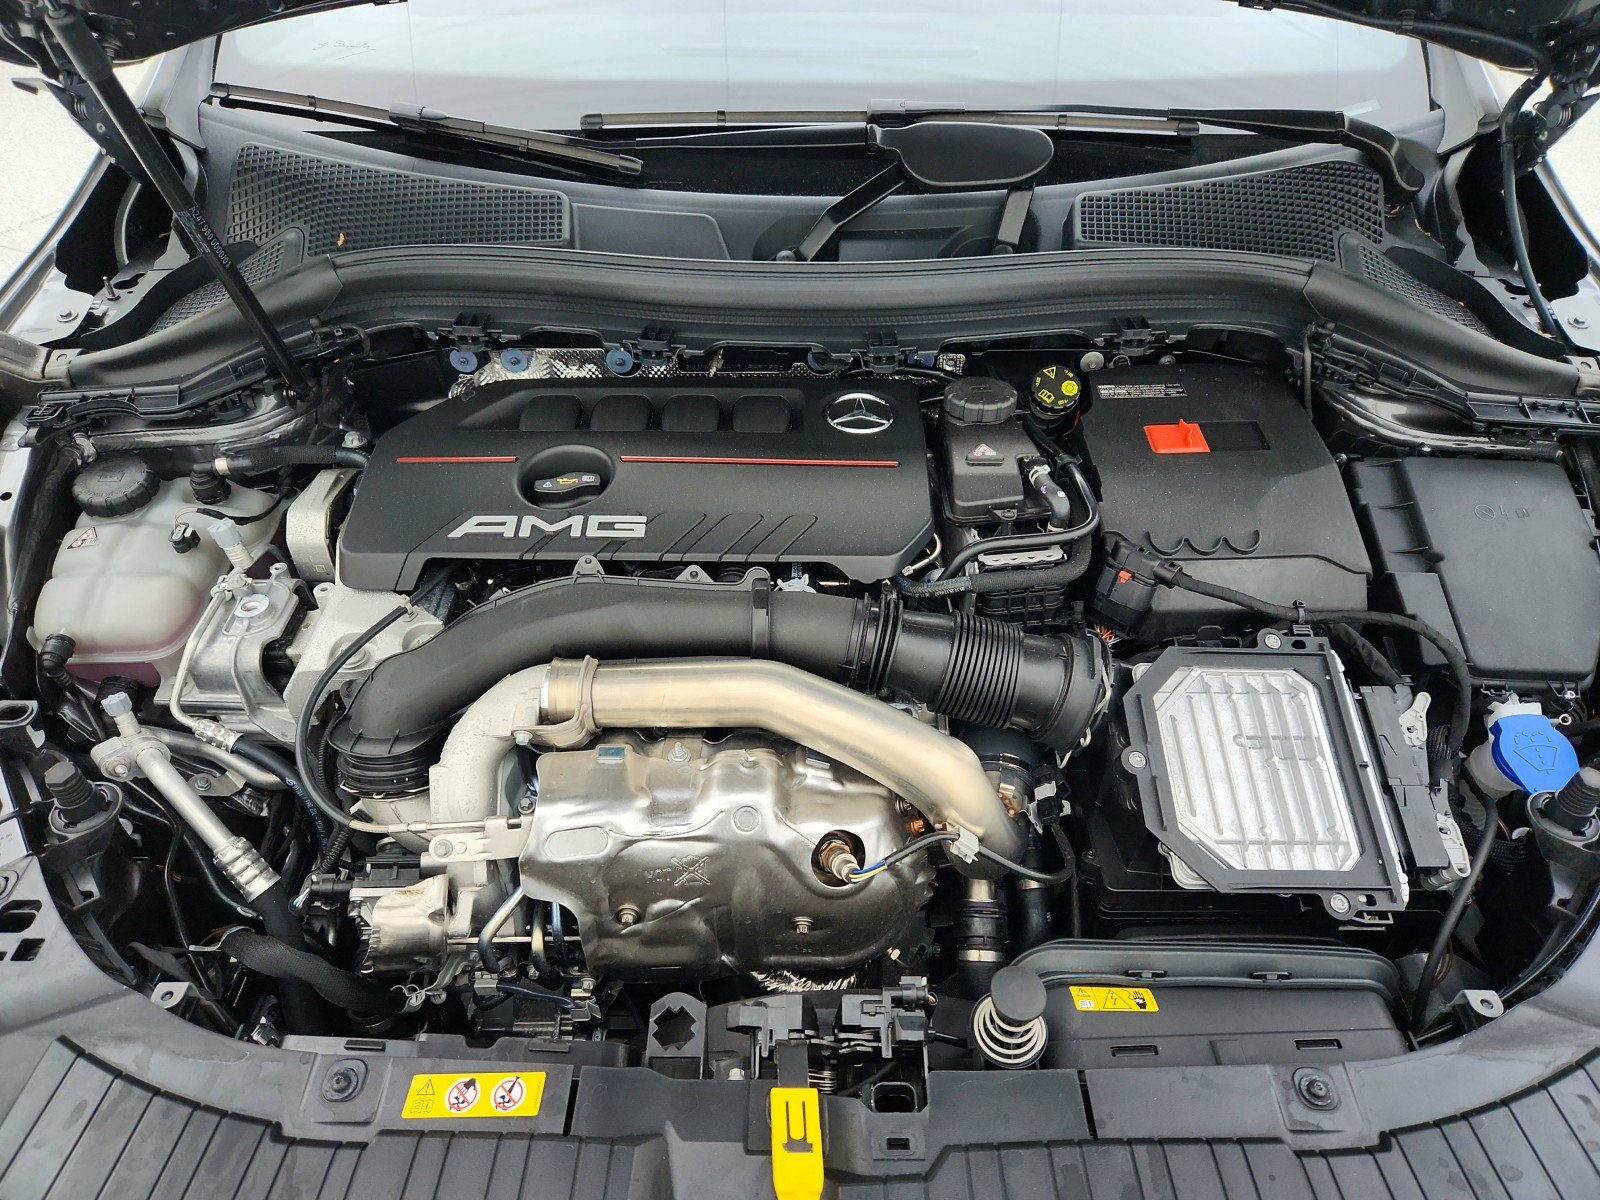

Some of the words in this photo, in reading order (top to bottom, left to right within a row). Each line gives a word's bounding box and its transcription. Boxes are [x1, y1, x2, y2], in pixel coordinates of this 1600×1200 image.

[189, 206, 206, 225] A247
[202, 224, 214, 240] 980
[447, 515, 648, 538] AMG
